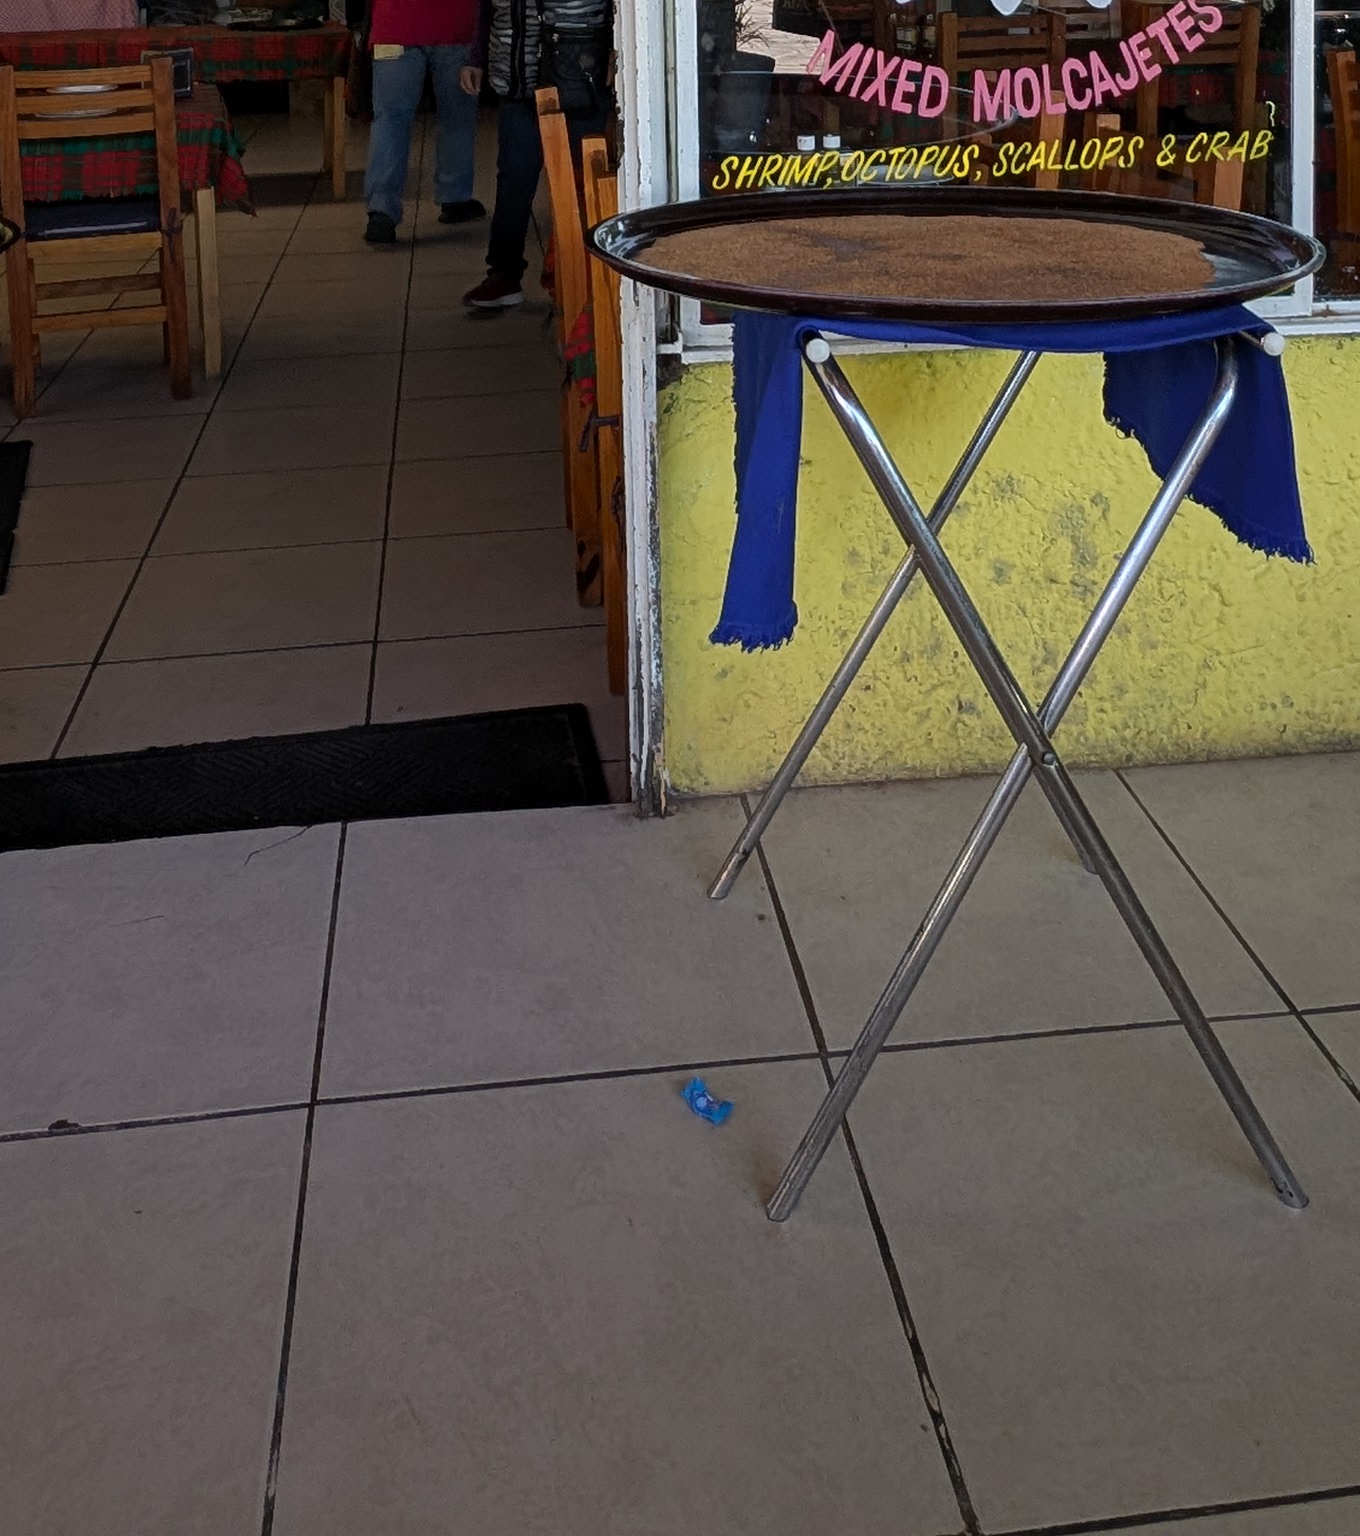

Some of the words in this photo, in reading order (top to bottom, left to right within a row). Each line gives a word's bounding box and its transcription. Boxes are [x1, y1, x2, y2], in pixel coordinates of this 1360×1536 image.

[805, 28, 949, 119] MIXED
[712, 149, 841, 191] SHRIMP,
[841, 144, 982, 185] OCTOPUS,
[992, 135, 1144, 178] SCALLOPS
[1156, 132, 1177, 164] &
[1185, 129, 1275, 164] CRAB
